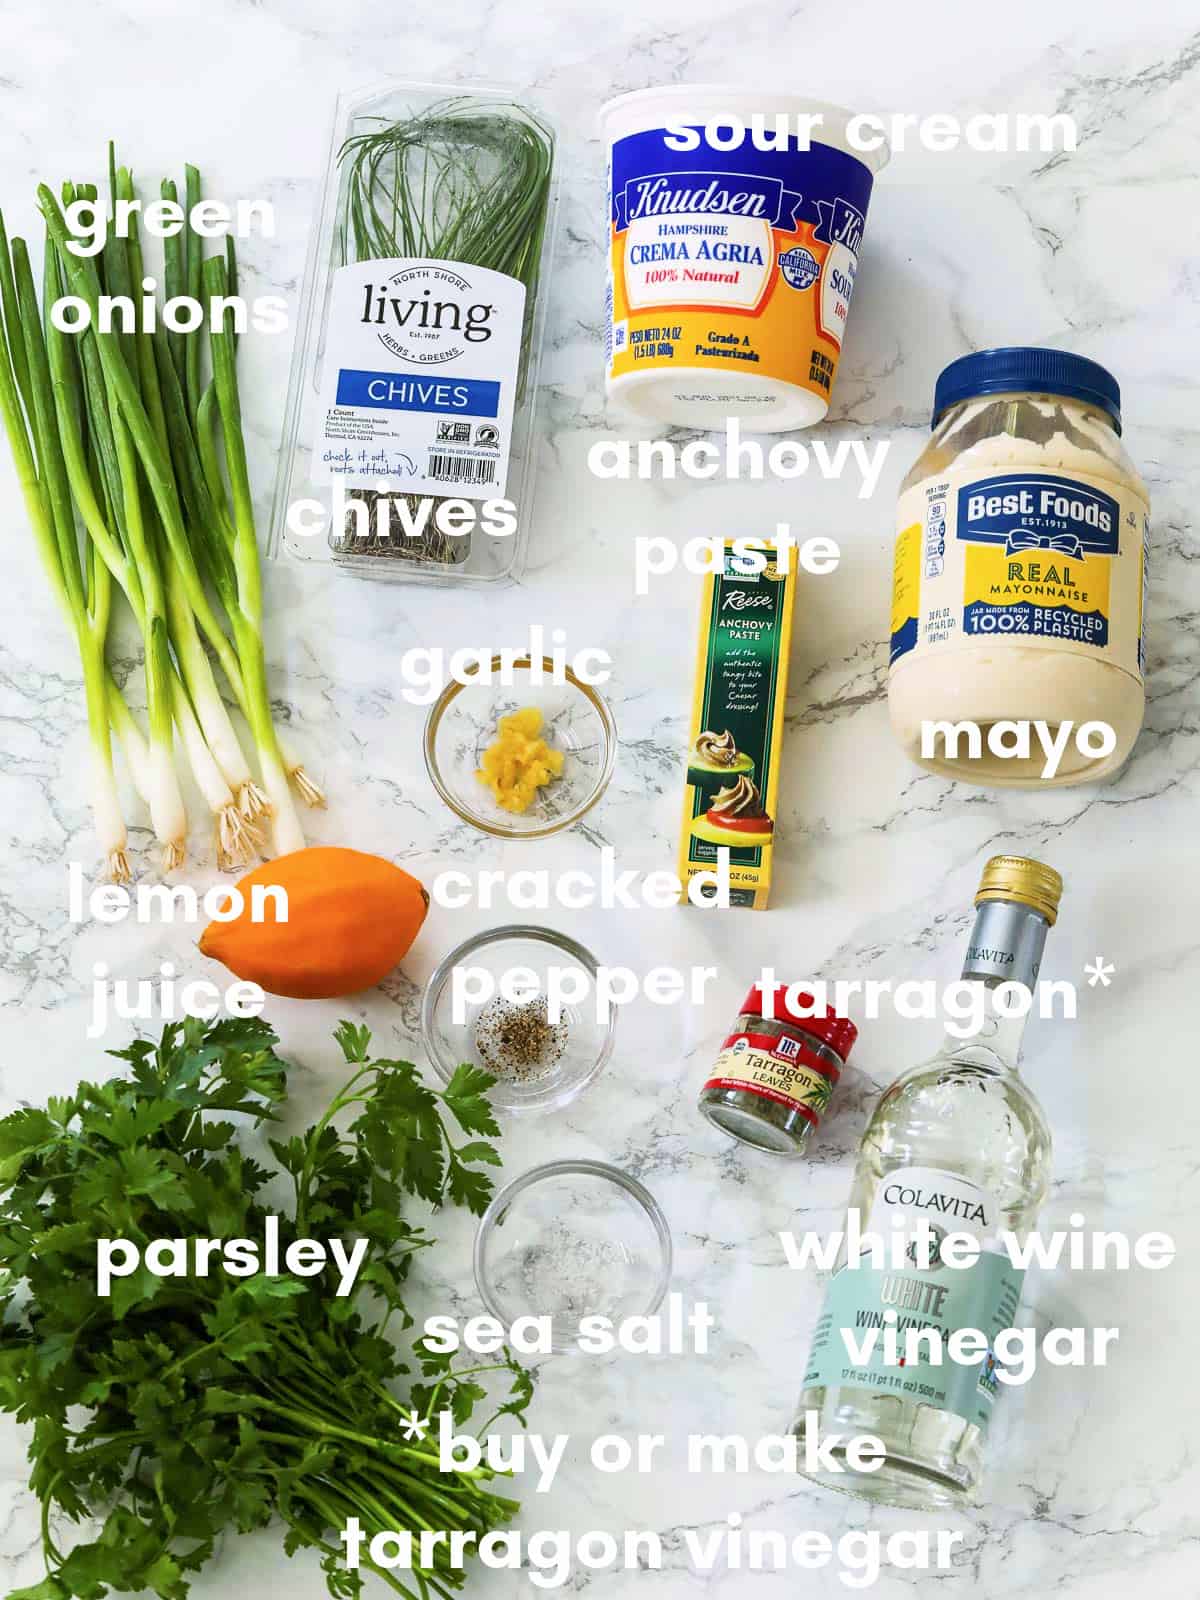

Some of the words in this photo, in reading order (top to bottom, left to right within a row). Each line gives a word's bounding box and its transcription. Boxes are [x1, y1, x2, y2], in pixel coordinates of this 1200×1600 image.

[630, 178, 767, 218] Knudsen
[658, 223, 729, 237] HAMPSHIRE
[630, 241, 691, 265] CREMA
[695, 239, 765, 266] AGRIA
[779, 254, 820, 275] CALIFORNIA
[393, 271, 430, 286] NORTH
[434, 271, 468, 291] SHORE
[644, 268, 678, 284] 100%
[682, 268, 739, 285] Natural
[360, 284, 493, 343] living
[644, 328, 660, 343] NETO
[661, 327, 671, 341] 24
[708, 331, 740, 344] Grado
[742, 335, 751, 347] A
[383, 332, 409, 357] HERBS
[419, 347, 460, 361] GREENS
[695, 345, 760, 362] Pasteurizada
[368, 379, 469, 407] CHIVES
[967, 490, 1034, 522] Best
[1040, 491, 1112, 533] Foods
[1021, 517, 1068, 529] EST.1913
[1007, 562, 1076, 587] REAL
[721, 590, 772, 611] Reese
[989, 584, 1089, 603] MAYONNAISE
[719, 619, 774, 631] ANCHOVY
[970, 614, 1030, 632] 100%
[1034, 608, 1103, 631] RECYCLED
[729, 630, 761, 641] PASTE
[1034, 621, 1094, 641] PLASTIC
[745, 1054, 812, 1089] Tarragon
[752, 1071, 793, 1092] LEAVES
[884, 1184, 989, 1227] COLAVITA
[880, 1275, 949, 1318] WHITE
